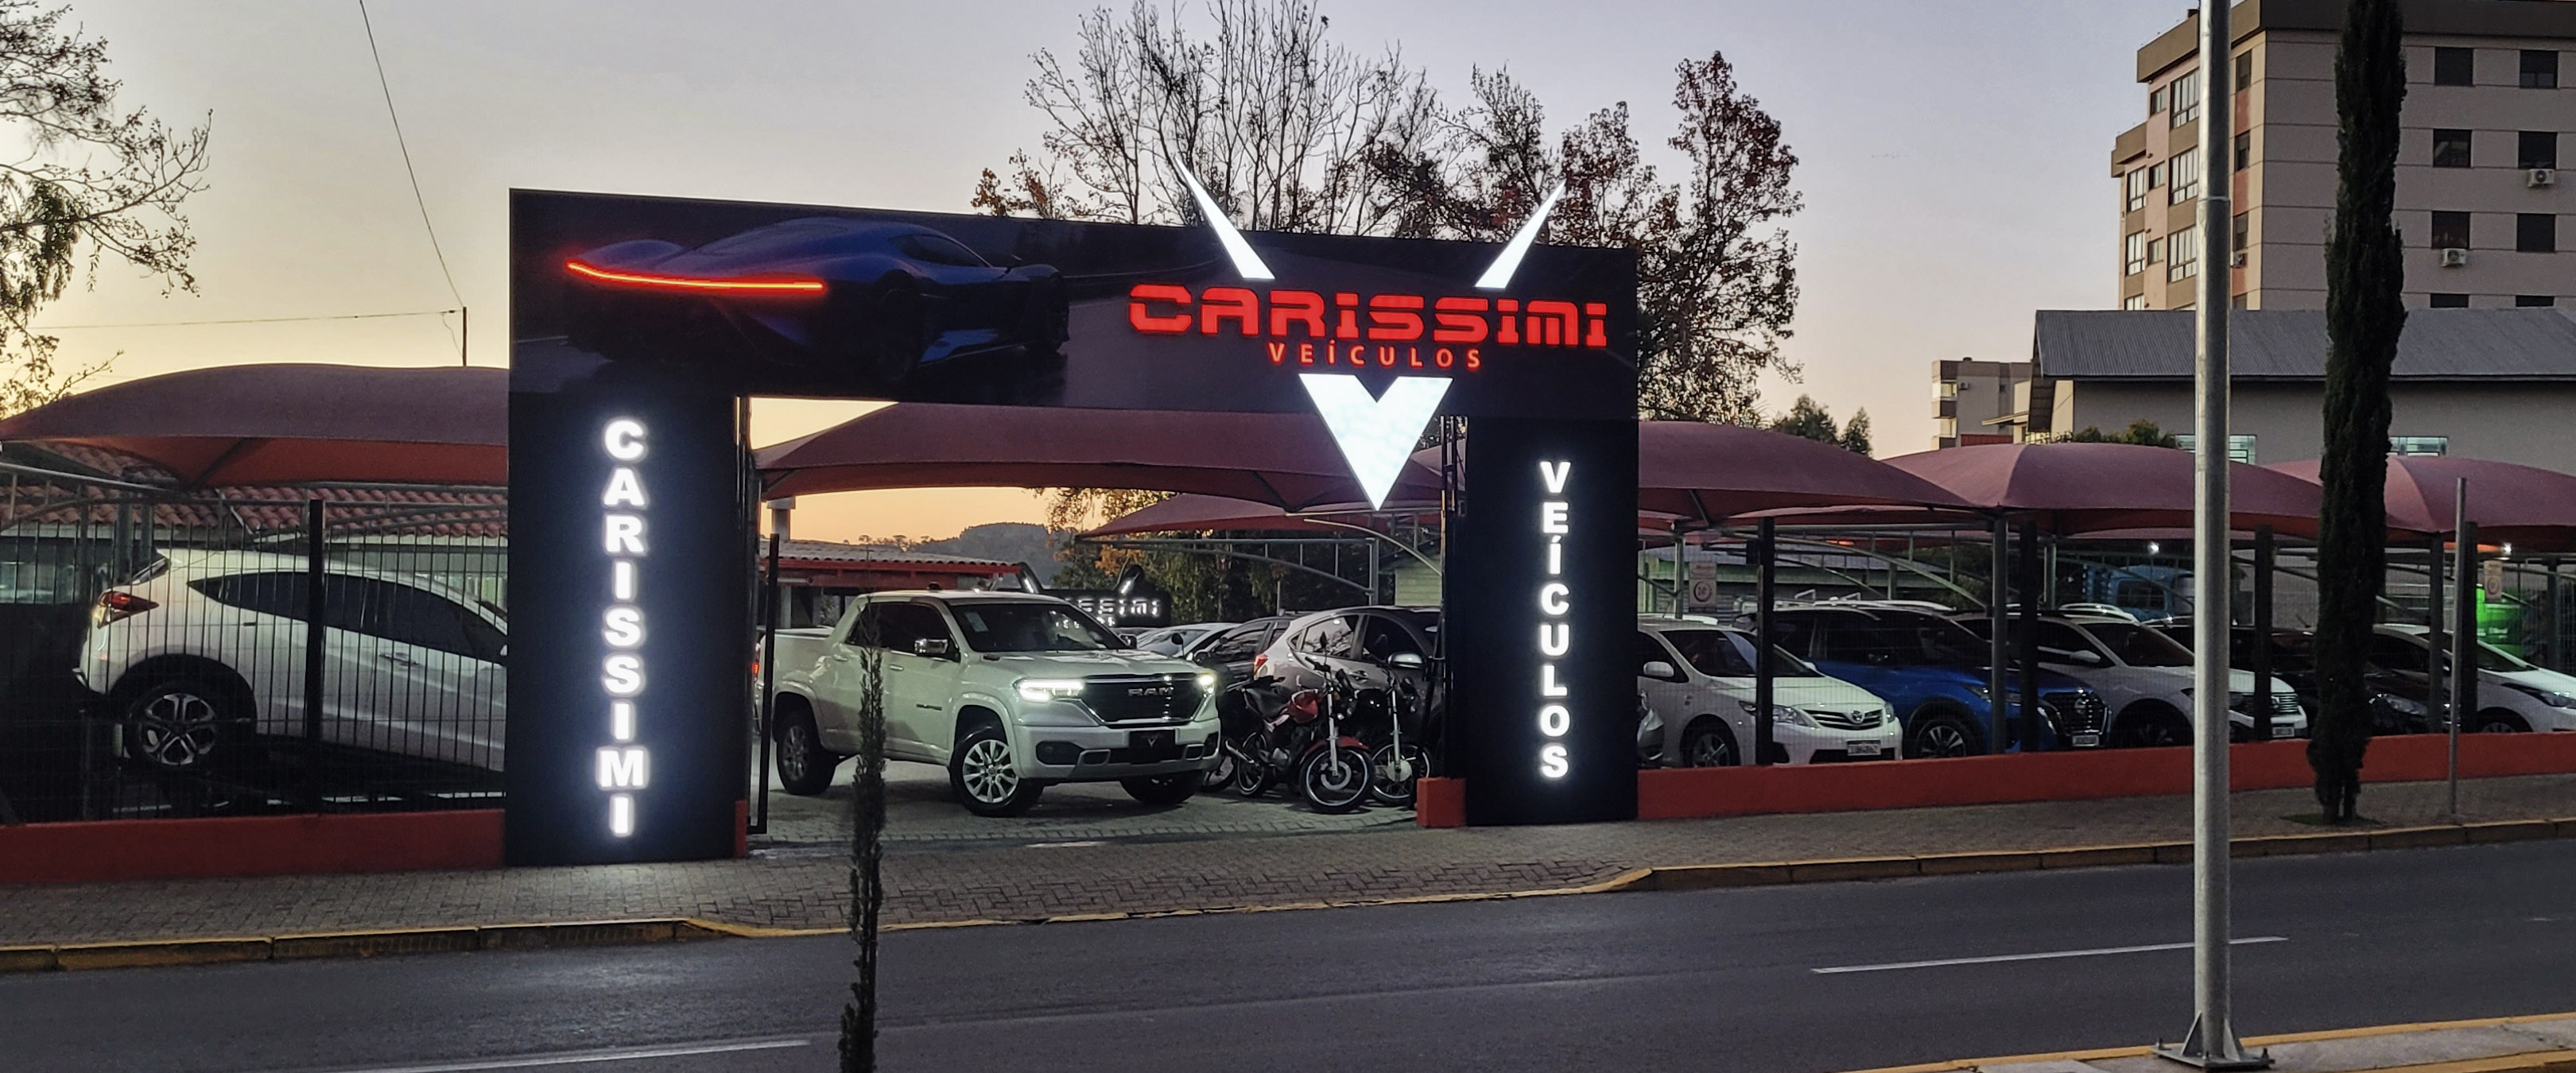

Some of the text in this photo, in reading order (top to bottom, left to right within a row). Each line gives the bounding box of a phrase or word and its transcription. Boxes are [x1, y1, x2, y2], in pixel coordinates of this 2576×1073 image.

[1269, 339, 1480, 368] VEÍCULOS
[599, 420, 646, 836] CARISSIMI
[1539, 461, 1571, 779] VEÍCULOS
